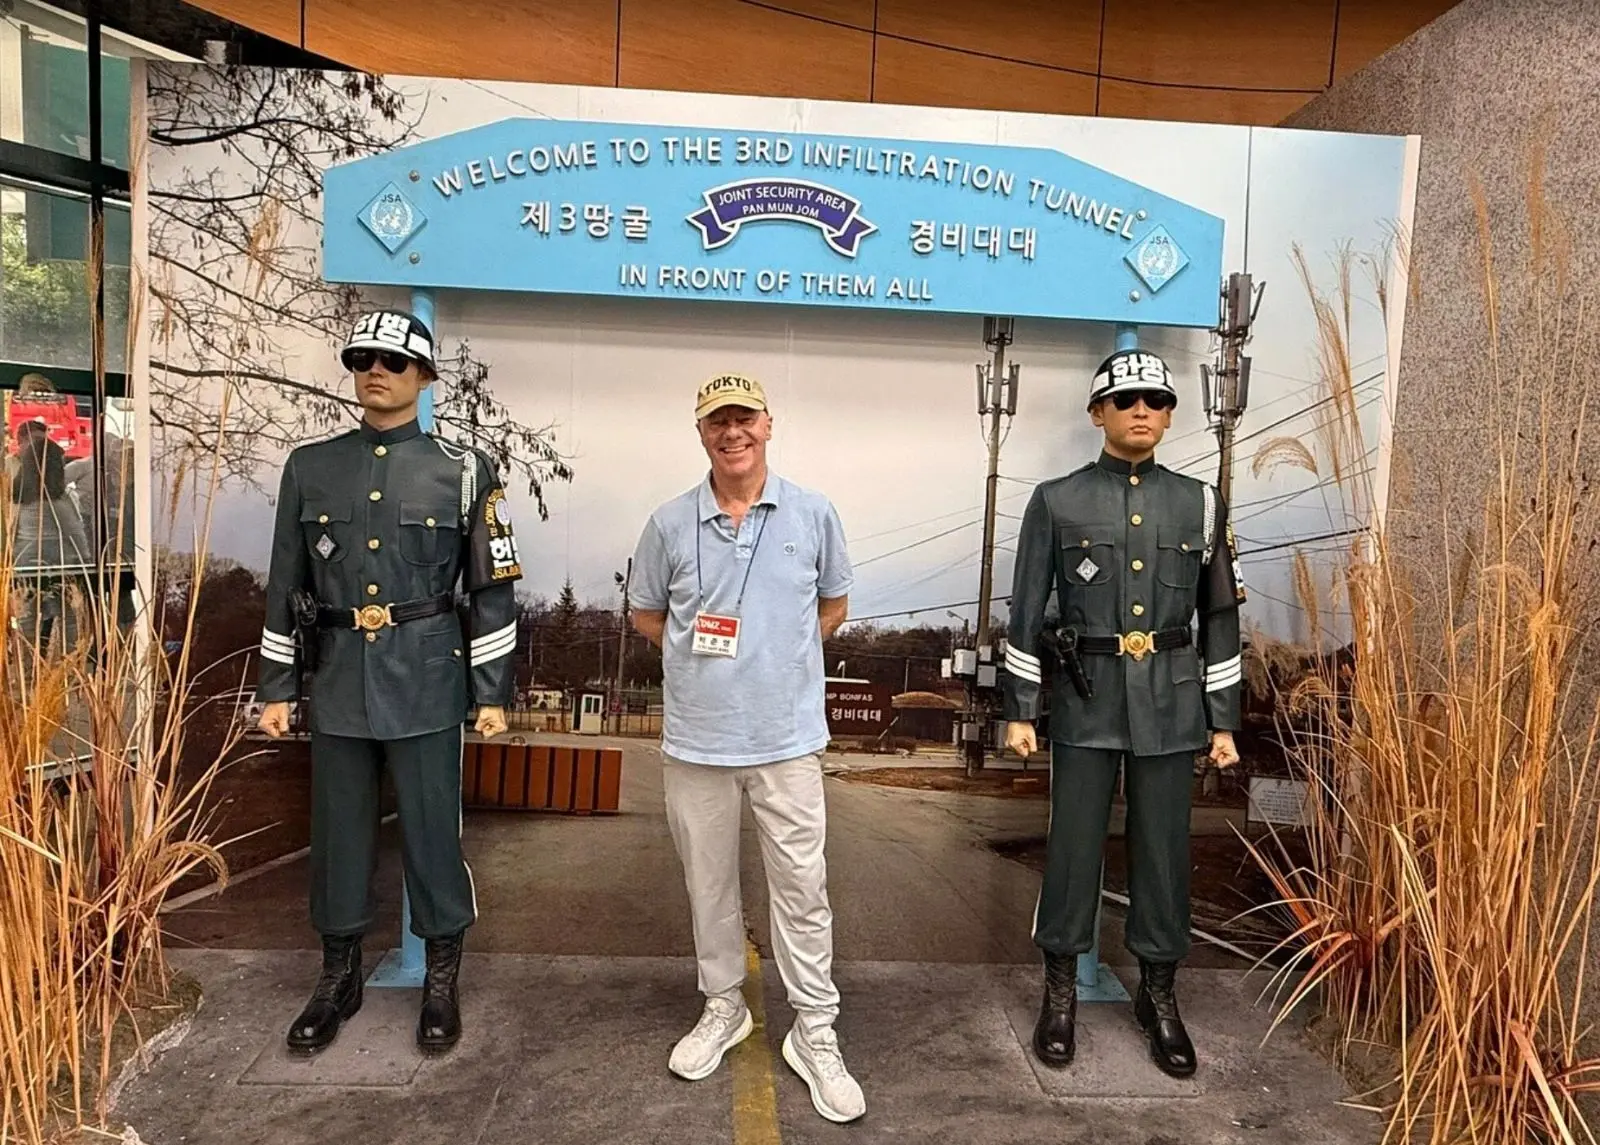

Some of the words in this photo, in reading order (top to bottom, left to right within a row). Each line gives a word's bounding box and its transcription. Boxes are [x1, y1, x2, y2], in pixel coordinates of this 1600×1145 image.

[381, 193, 402, 203] JSA
[432, 141, 597, 196] WELCOME
[609, 138, 650, 163] TO
[662, 136, 722, 162] THE
[736, 137, 793, 164] 3RD
[803, 140, 1015, 196] INFILTRATION
[1028, 178, 1135, 241] TUNNEL
[719, 188, 752, 206] JOINT
[755, 186, 815, 201] SECURITY
[815, 191, 847, 213] AREA
[520, 200, 652, 239] 제3땅굴
[742, 203, 765, 215] PAN
[767, 202, 794, 213] MUN
[796, 204, 819, 218] JOM
[909, 220, 1037, 260] 경비대대
[1149, 235, 1169, 245] JSA
[620, 264, 647, 286] IN
[658, 265, 746, 289] FRONT
[756, 269, 791, 292] OF
[801, 272, 877, 296] THEM
[886, 277, 934, 300] ALL
[351, 311, 412, 347] 헌병
[1111, 353, 1166, 386] 헌병
[705, 376, 751, 395] TOKYO
[839, 693, 873, 702] BONIFAS
[831, 707, 882, 722] 경비대대
